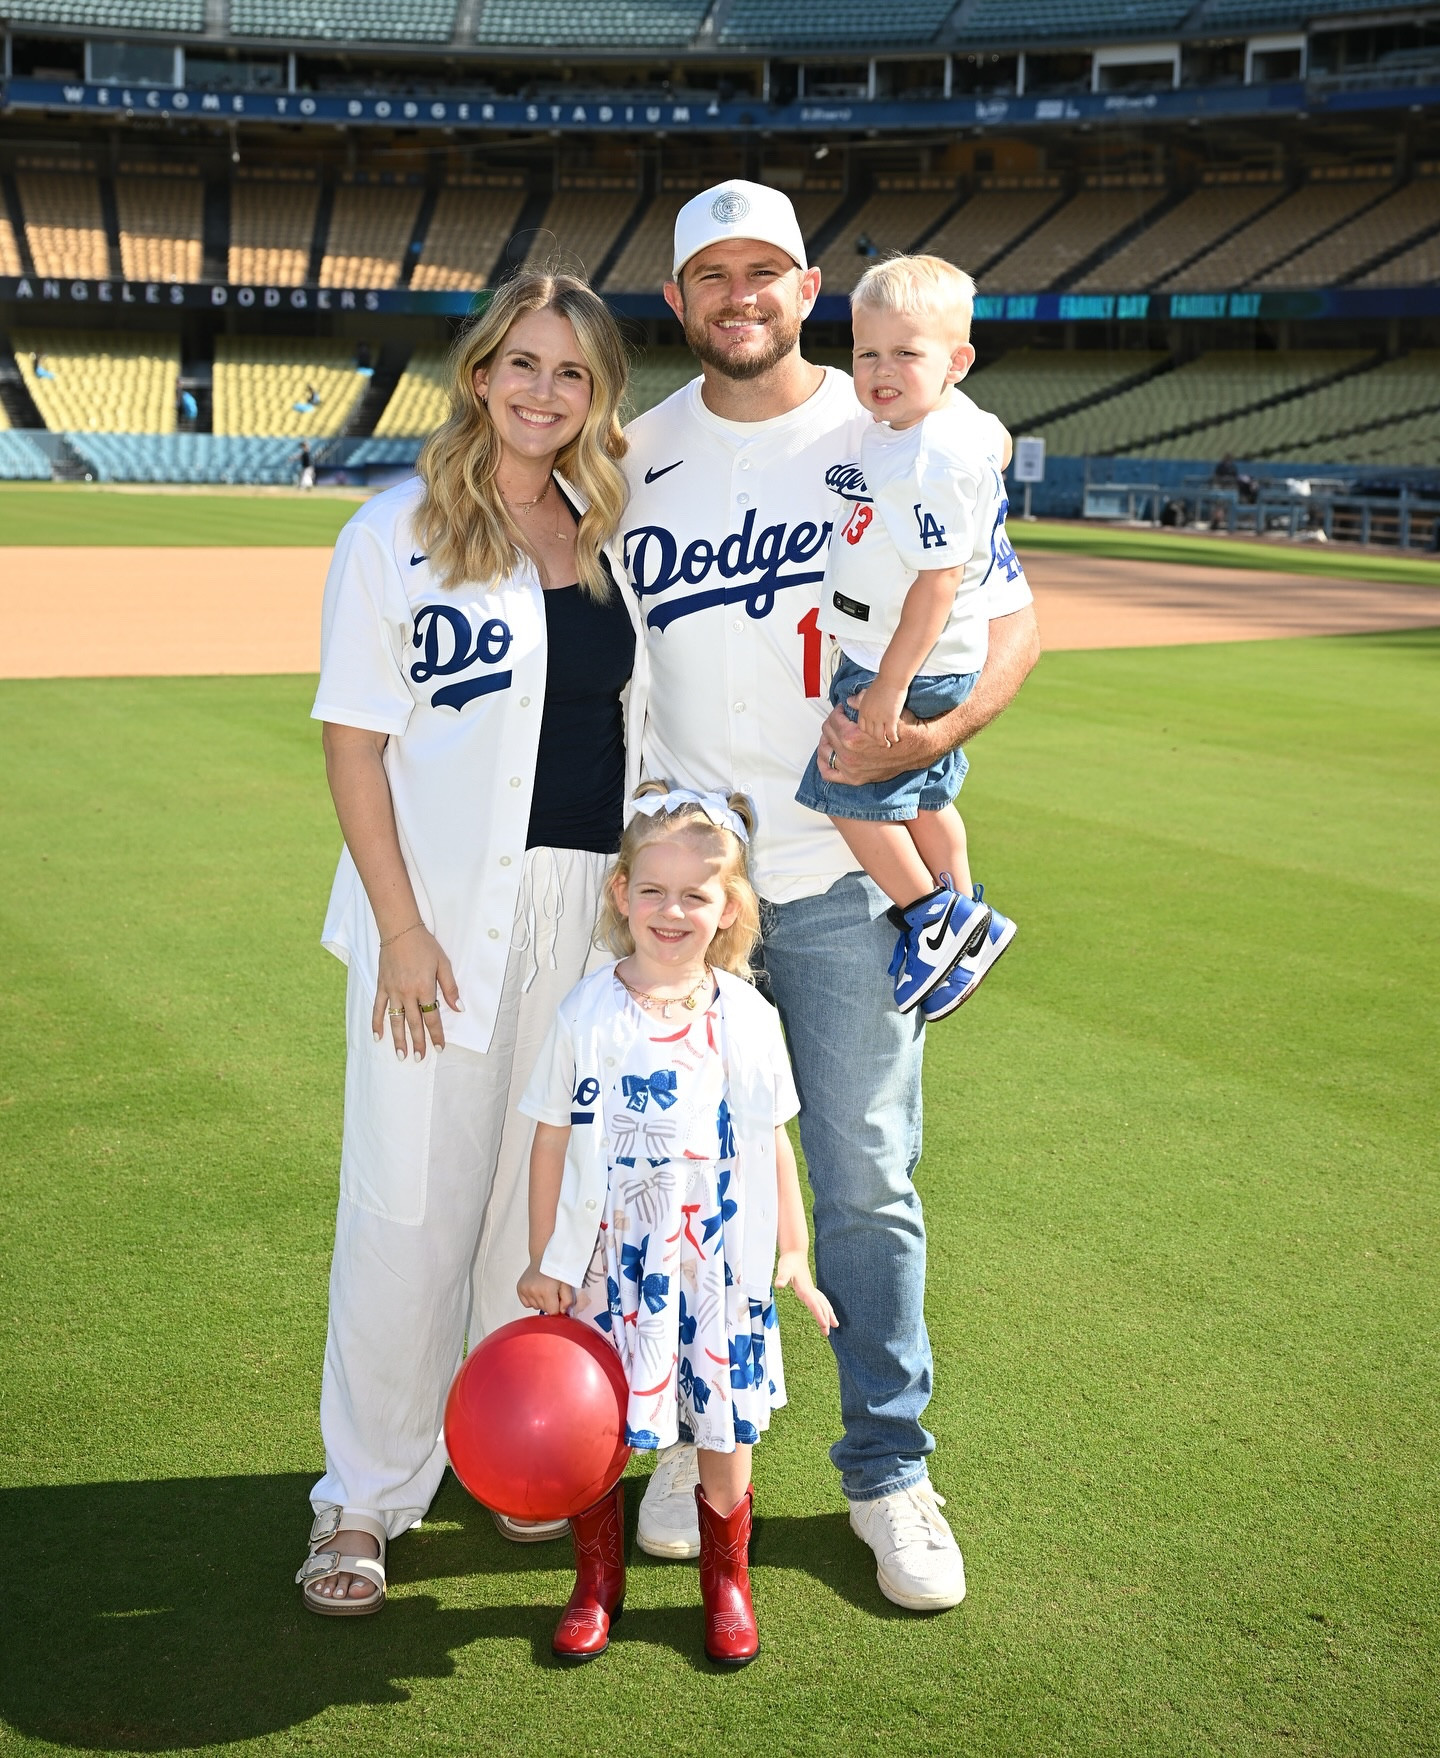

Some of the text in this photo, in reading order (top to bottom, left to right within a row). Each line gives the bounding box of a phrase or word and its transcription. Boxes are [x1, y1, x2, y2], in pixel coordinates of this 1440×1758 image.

[63, 85, 690, 123] WELCOME TO DODGER STADIUM
[15, 278, 380, 311] ANGELES DODGERS
[1059, 295, 1115, 320] FAMILY
[1170, 294, 1228, 319] FAMILY
[841, 502, 873, 546] 13
[913, 503, 948, 549] LA
[410, 604, 515, 684] Do
[797, 607, 829, 699] 1
[571, 1068, 601, 1107] o
